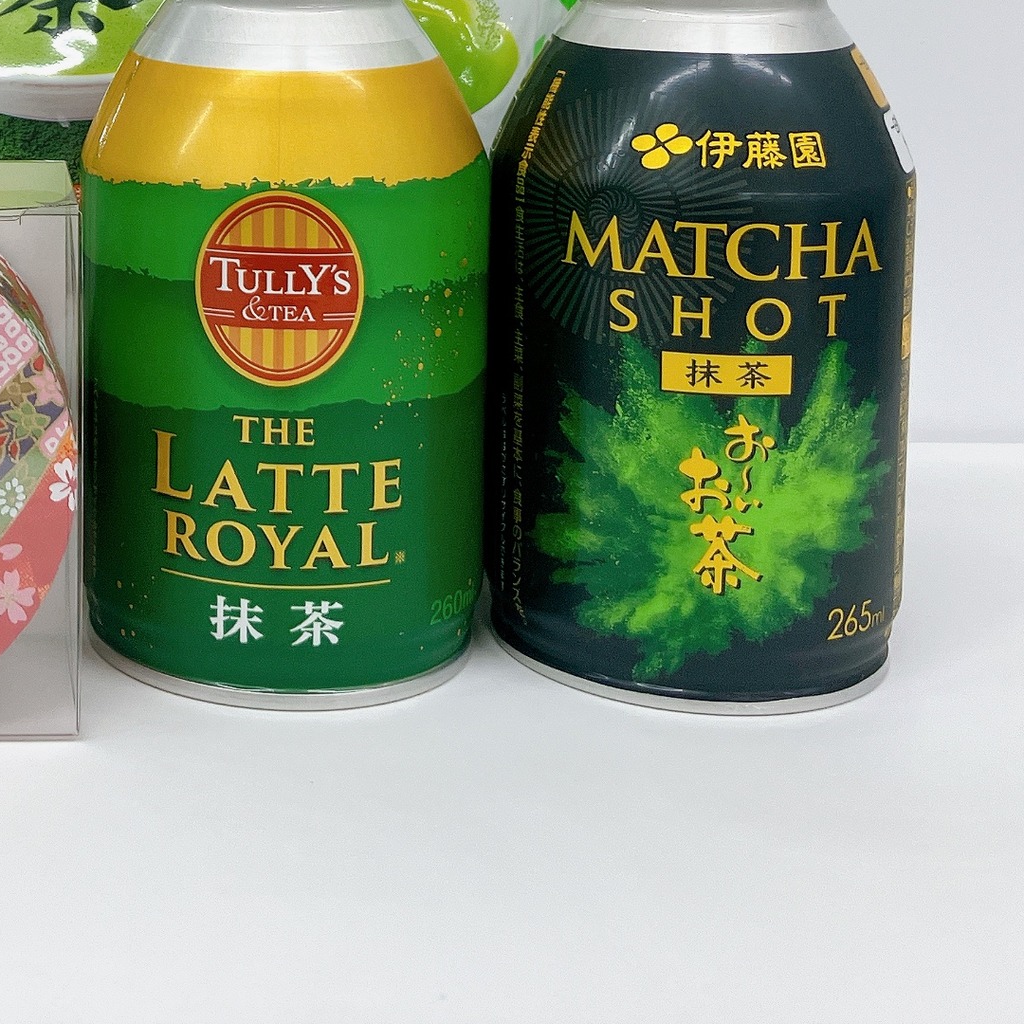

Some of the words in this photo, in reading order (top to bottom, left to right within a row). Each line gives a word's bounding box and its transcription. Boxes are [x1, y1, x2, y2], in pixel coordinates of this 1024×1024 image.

[695, 129, 827, 170] 伊藤園
[561, 209, 883, 281] MATCHA
[208, 255, 352, 296] TULLY'S
[609, 287, 848, 343] SHOT
[685, 358, 773, 390] 抹茶
[232, 414, 316, 447] THE
[150, 428, 404, 515] LATTE
[161, 509, 390, 571] ROYAL
[209, 594, 345, 647] 抹茶
[827, 599, 885, 641] 265ml
